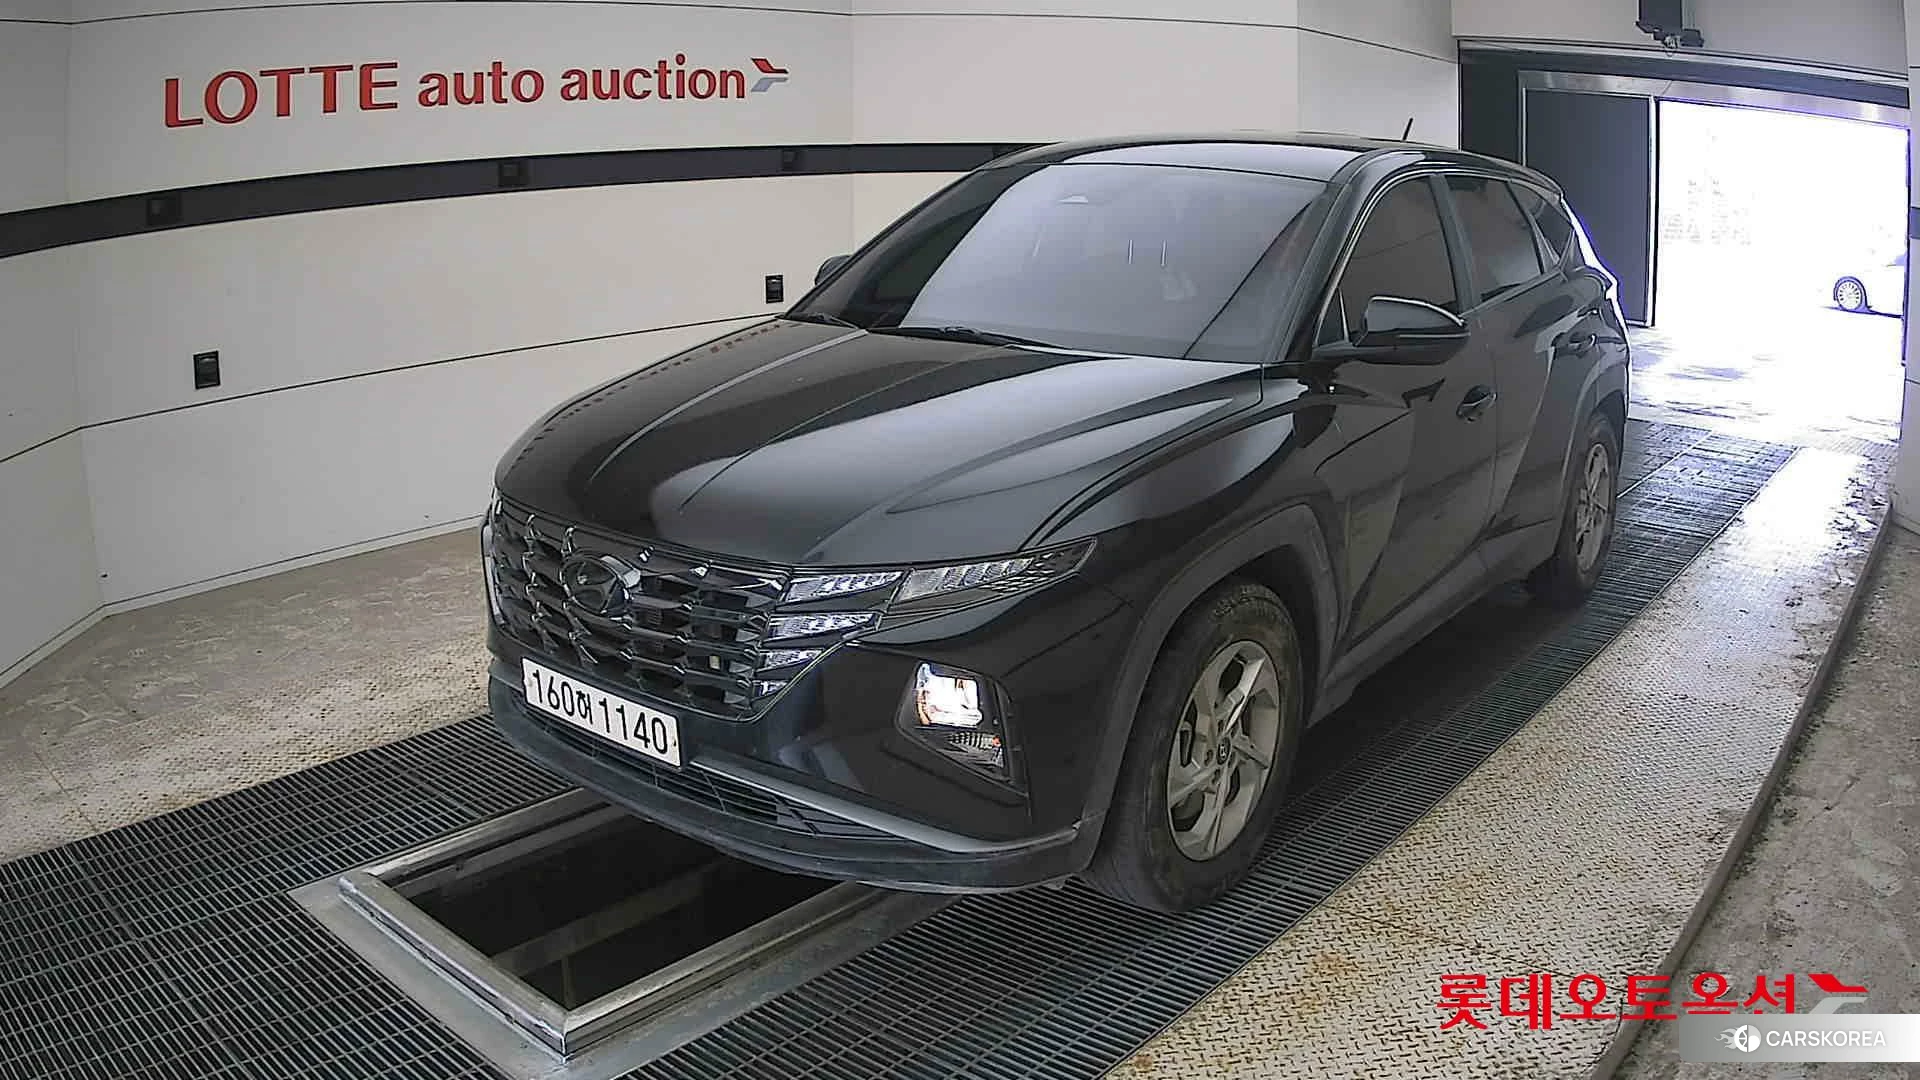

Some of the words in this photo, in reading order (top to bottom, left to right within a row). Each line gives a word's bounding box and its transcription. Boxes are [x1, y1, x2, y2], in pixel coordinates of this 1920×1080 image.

[164, 62, 399, 128] LOTTE
[417, 61, 545, 107] auto
[560, 53, 747, 101] auction
[532, 669, 594, 725] 160허
[599, 697, 668, 754] 1140
